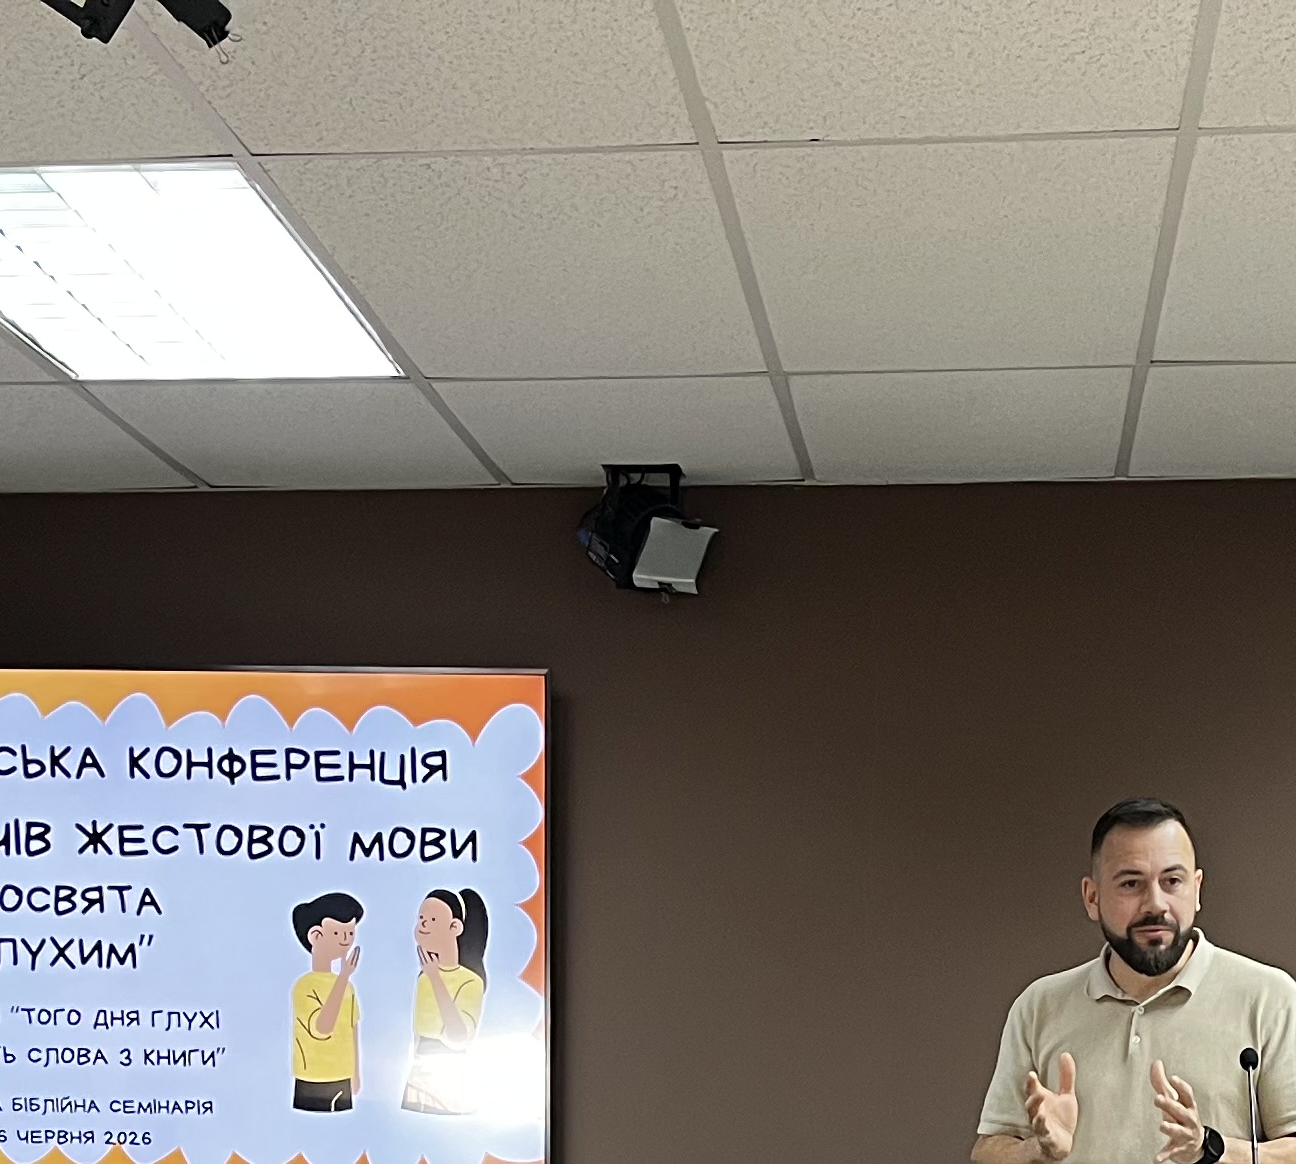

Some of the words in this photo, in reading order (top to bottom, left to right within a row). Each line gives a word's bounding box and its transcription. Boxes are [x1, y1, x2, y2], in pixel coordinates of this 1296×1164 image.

[128, 745, 448, 791] КОНФЕРЕНЦІЯ
[74, 819, 326, 861] ЖЕСТОВОЇ
[348, 826, 478, 864] МОВИ
[93, 1009, 141, 1030] ДНЯ
[151, 1009, 220, 1032] ГЛУХІ
[27, 1047, 109, 1068] СЛОВА
[11, 1095, 101, 1116] БІБЛІЙНА
[109, 1098, 214, 1116] СЕМІНАРІЯ
[16, 1129, 95, 1146] ЧЕРВНЯ
[103, 1130, 152, 1146] 2026
